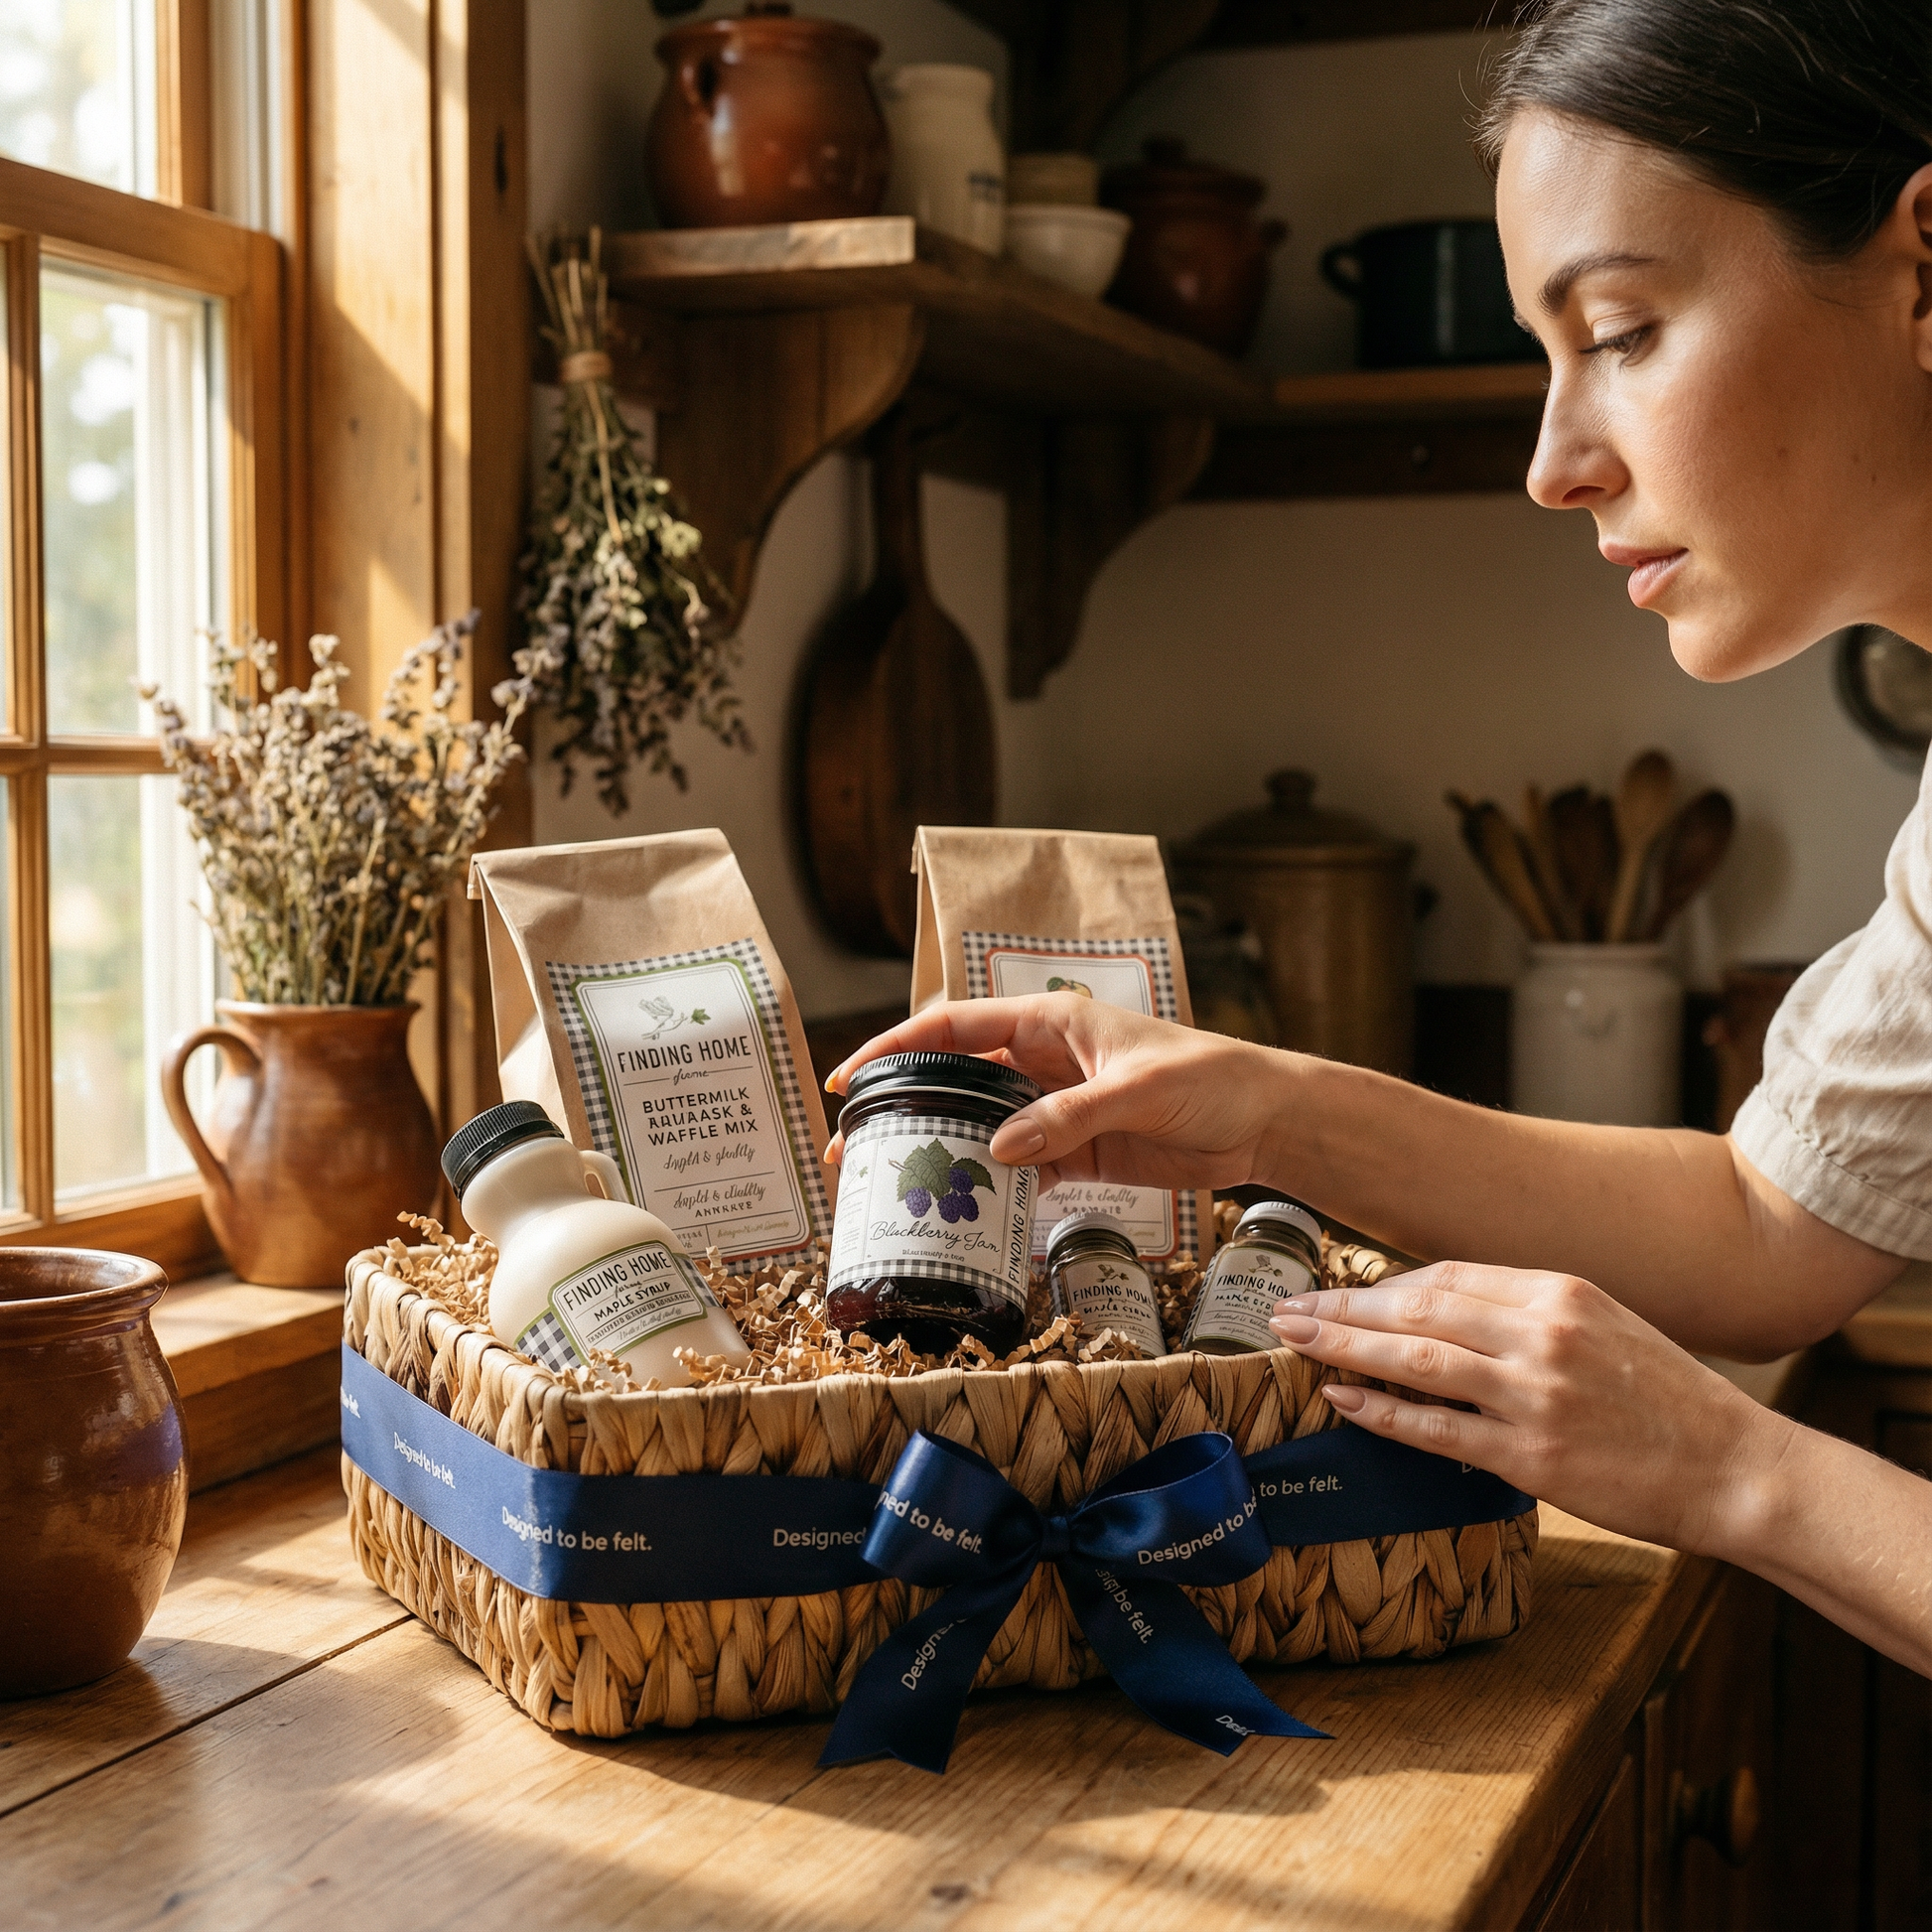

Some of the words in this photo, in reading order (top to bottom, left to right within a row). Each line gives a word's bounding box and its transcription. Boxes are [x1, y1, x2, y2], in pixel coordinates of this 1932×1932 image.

[618, 1043, 693, 1073] FINDING
[698, 1035, 752, 1061] HOME
[642, 1087, 750, 1114] BUTTERMILK
[741, 1103, 753, 1116] &
[647, 1125, 719, 1147] WAFFLE
[725, 1119, 759, 1136] MIX
[563, 1264, 627, 1311] FINDING
[627, 1252, 671, 1277] HOME
[1073, 1285, 1122, 1302] FINDING
[594, 1294, 634, 1321] MAPLE
[634, 1281, 671, 1301] SYRUP
[1259, 1481, 1278, 1497] to
[1282, 1479, 1305, 1495] be
[1309, 1474, 1343, 1492] felt.
[502, 1506, 552, 1544] Designed
[557, 1530, 577, 1549] to
[581, 1532, 609, 1551] be
[613, 1532, 652, 1551] felt.
[909, 1507, 930, 1529] to
[931, 1517, 955, 1542] be
[956, 1528, 982, 1554] felt.
[1138, 1522, 1225, 1565] Designed
[1225, 1513, 1244, 1532] to
[1113, 1588, 1132, 1613] be
